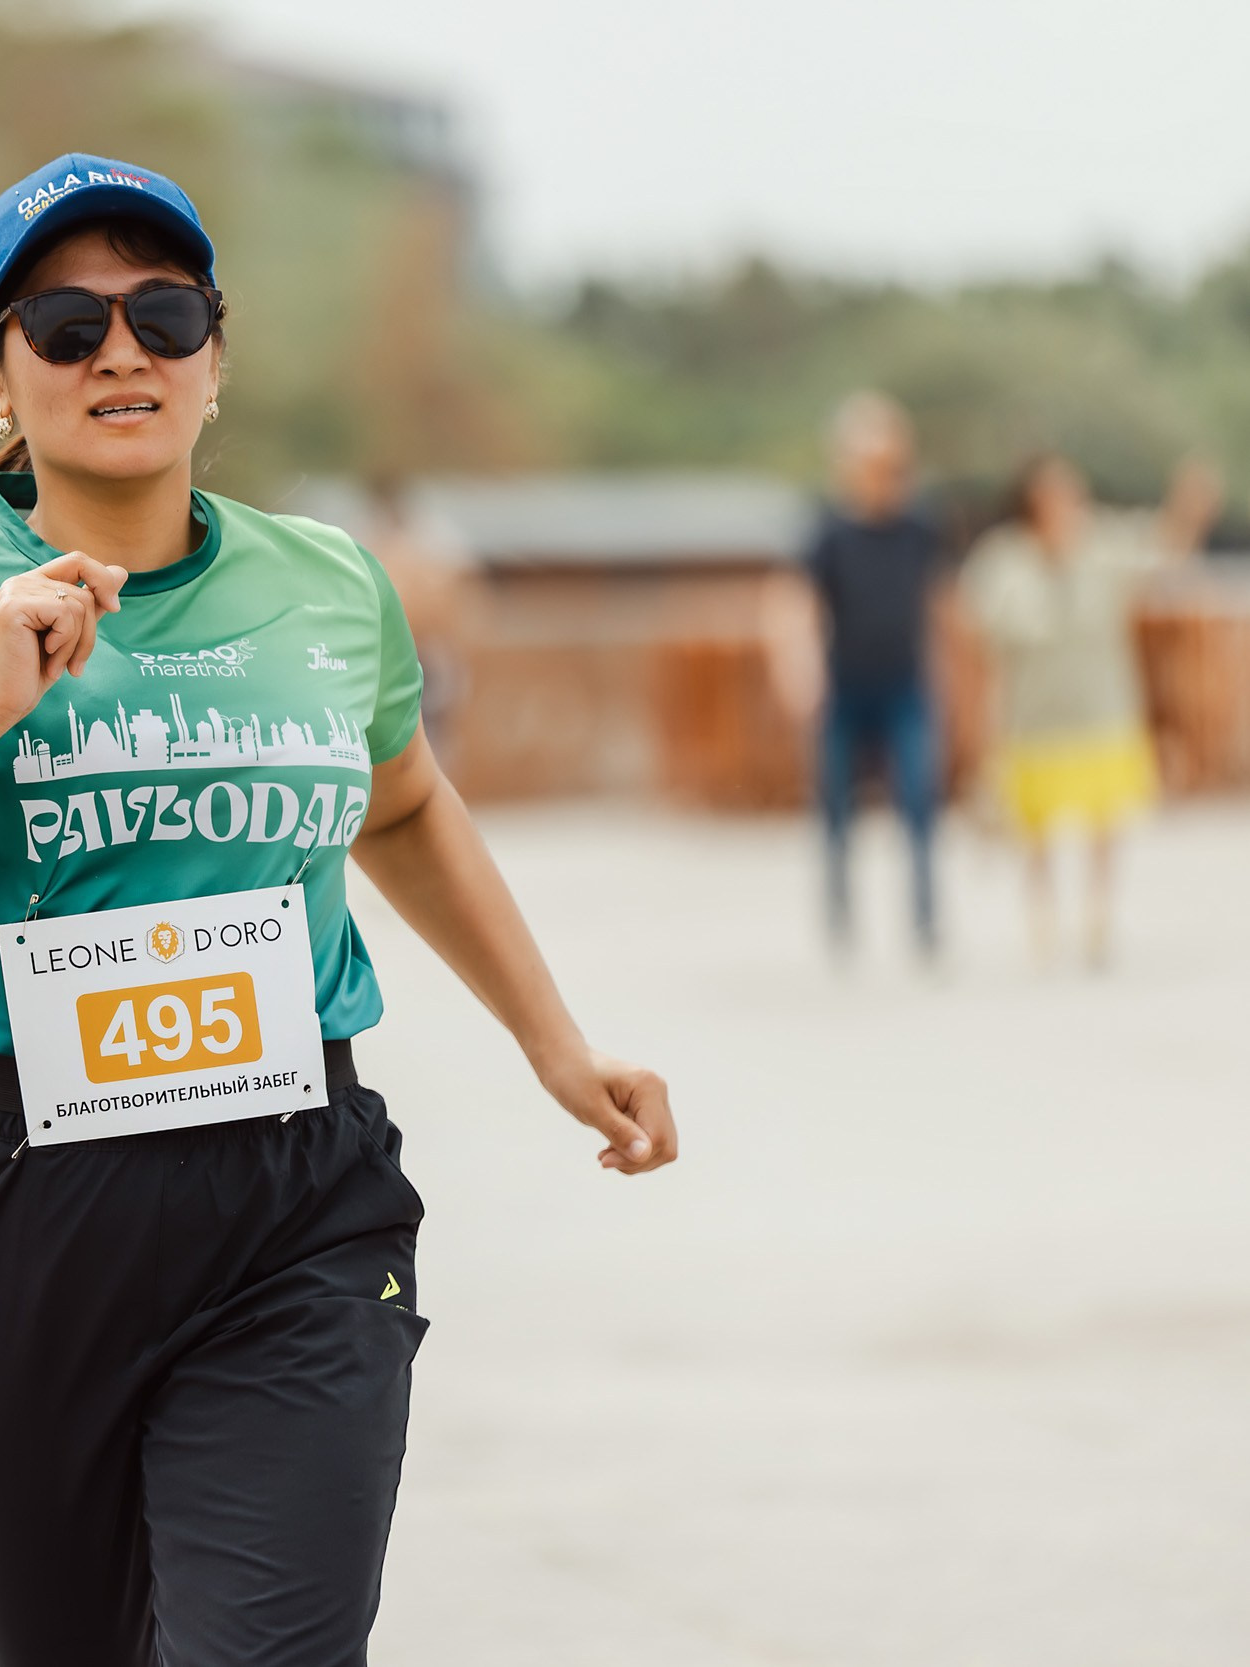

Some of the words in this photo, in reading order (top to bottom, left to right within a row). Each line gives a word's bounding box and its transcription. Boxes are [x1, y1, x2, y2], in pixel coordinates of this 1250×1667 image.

[18, 173, 82, 214] QALA
[88, 171, 143, 189] RUN
[140, 662, 246, 677] marathon
[20, 781, 367, 862] PAVLODAR
[30, 938, 137, 975] LEONE
[194, 918, 282, 952] D'ORO
[100, 986, 243, 1066] 495
[56, 1076, 249, 1117] БЛАГОТВОРИТЕЛЬНЫЙ
[253, 1071, 298, 1091] ЗАБЕГ
